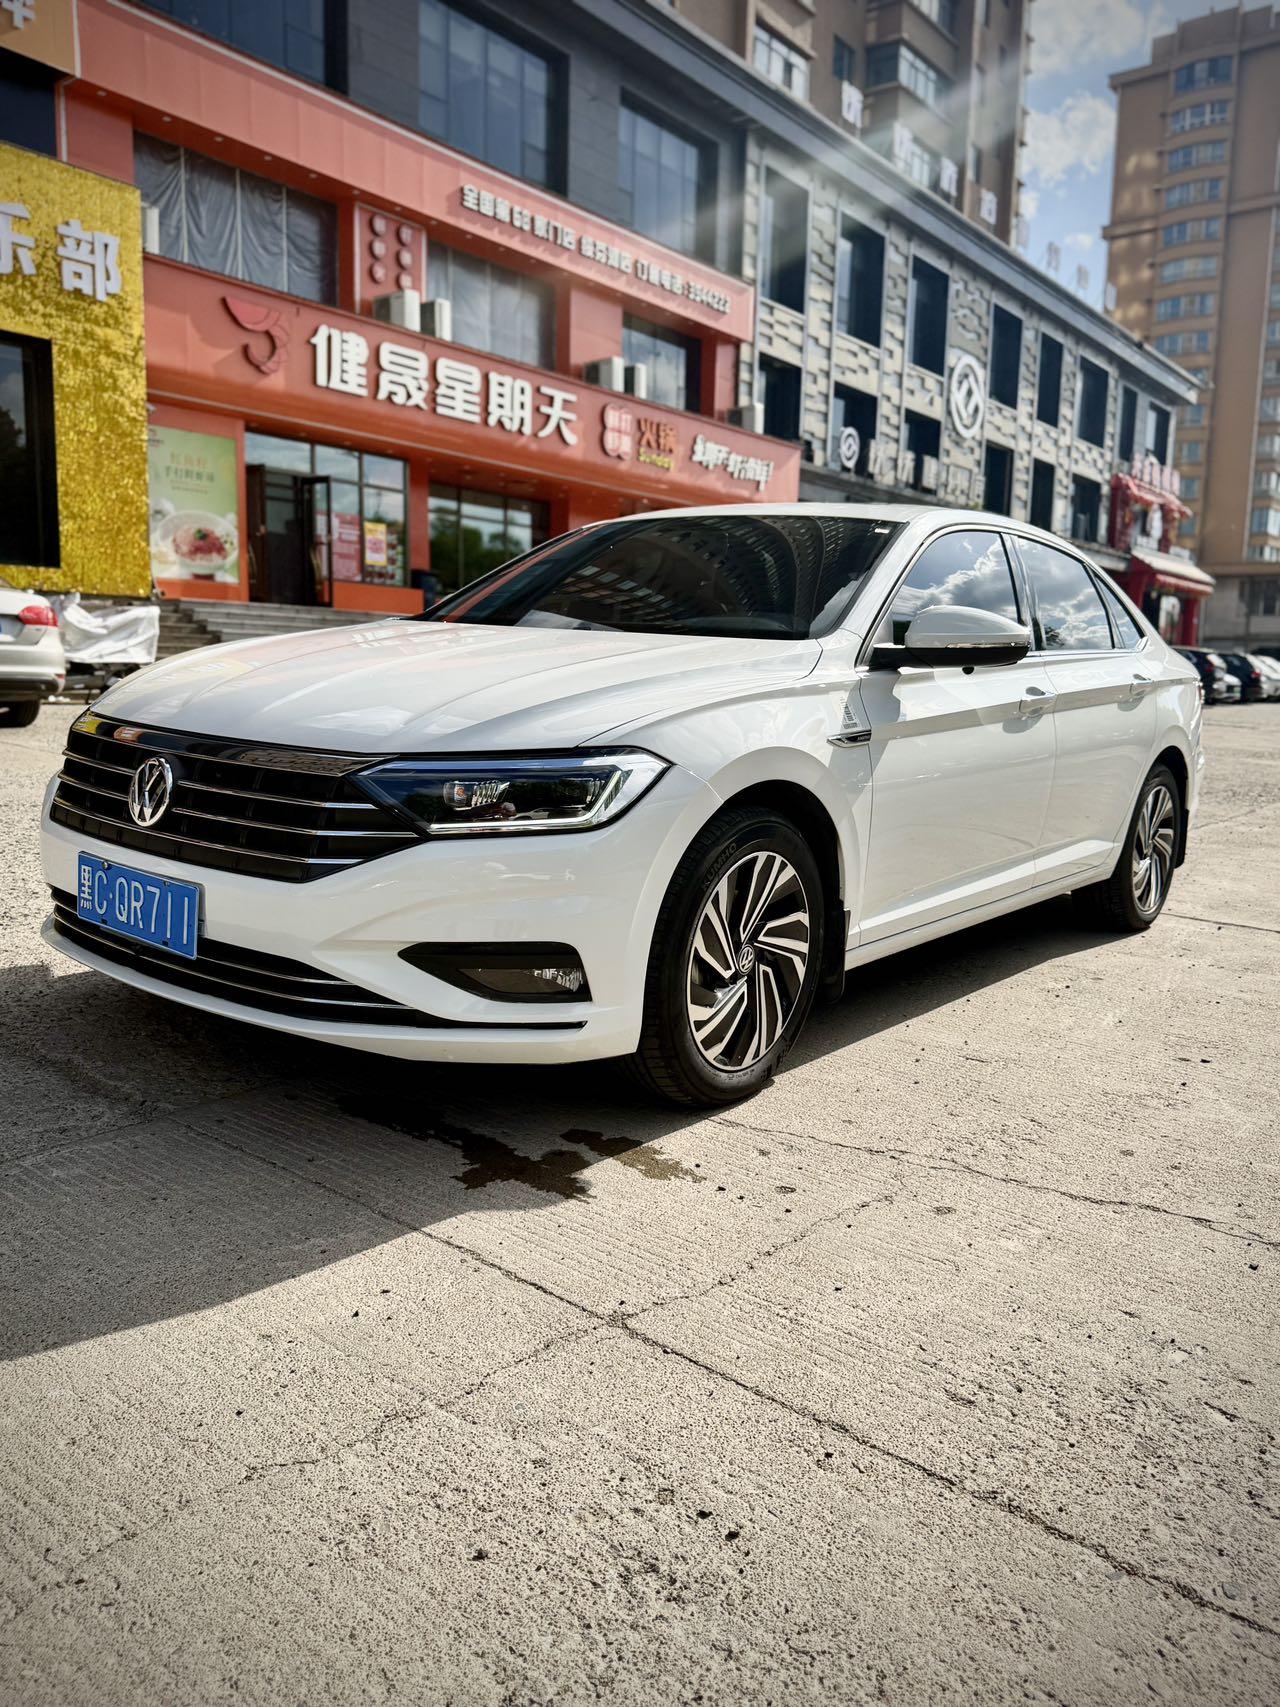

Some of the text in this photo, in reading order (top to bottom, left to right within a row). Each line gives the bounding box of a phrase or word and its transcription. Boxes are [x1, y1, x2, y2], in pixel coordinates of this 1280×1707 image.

[309, 323, 579, 446] 健晟星期天
